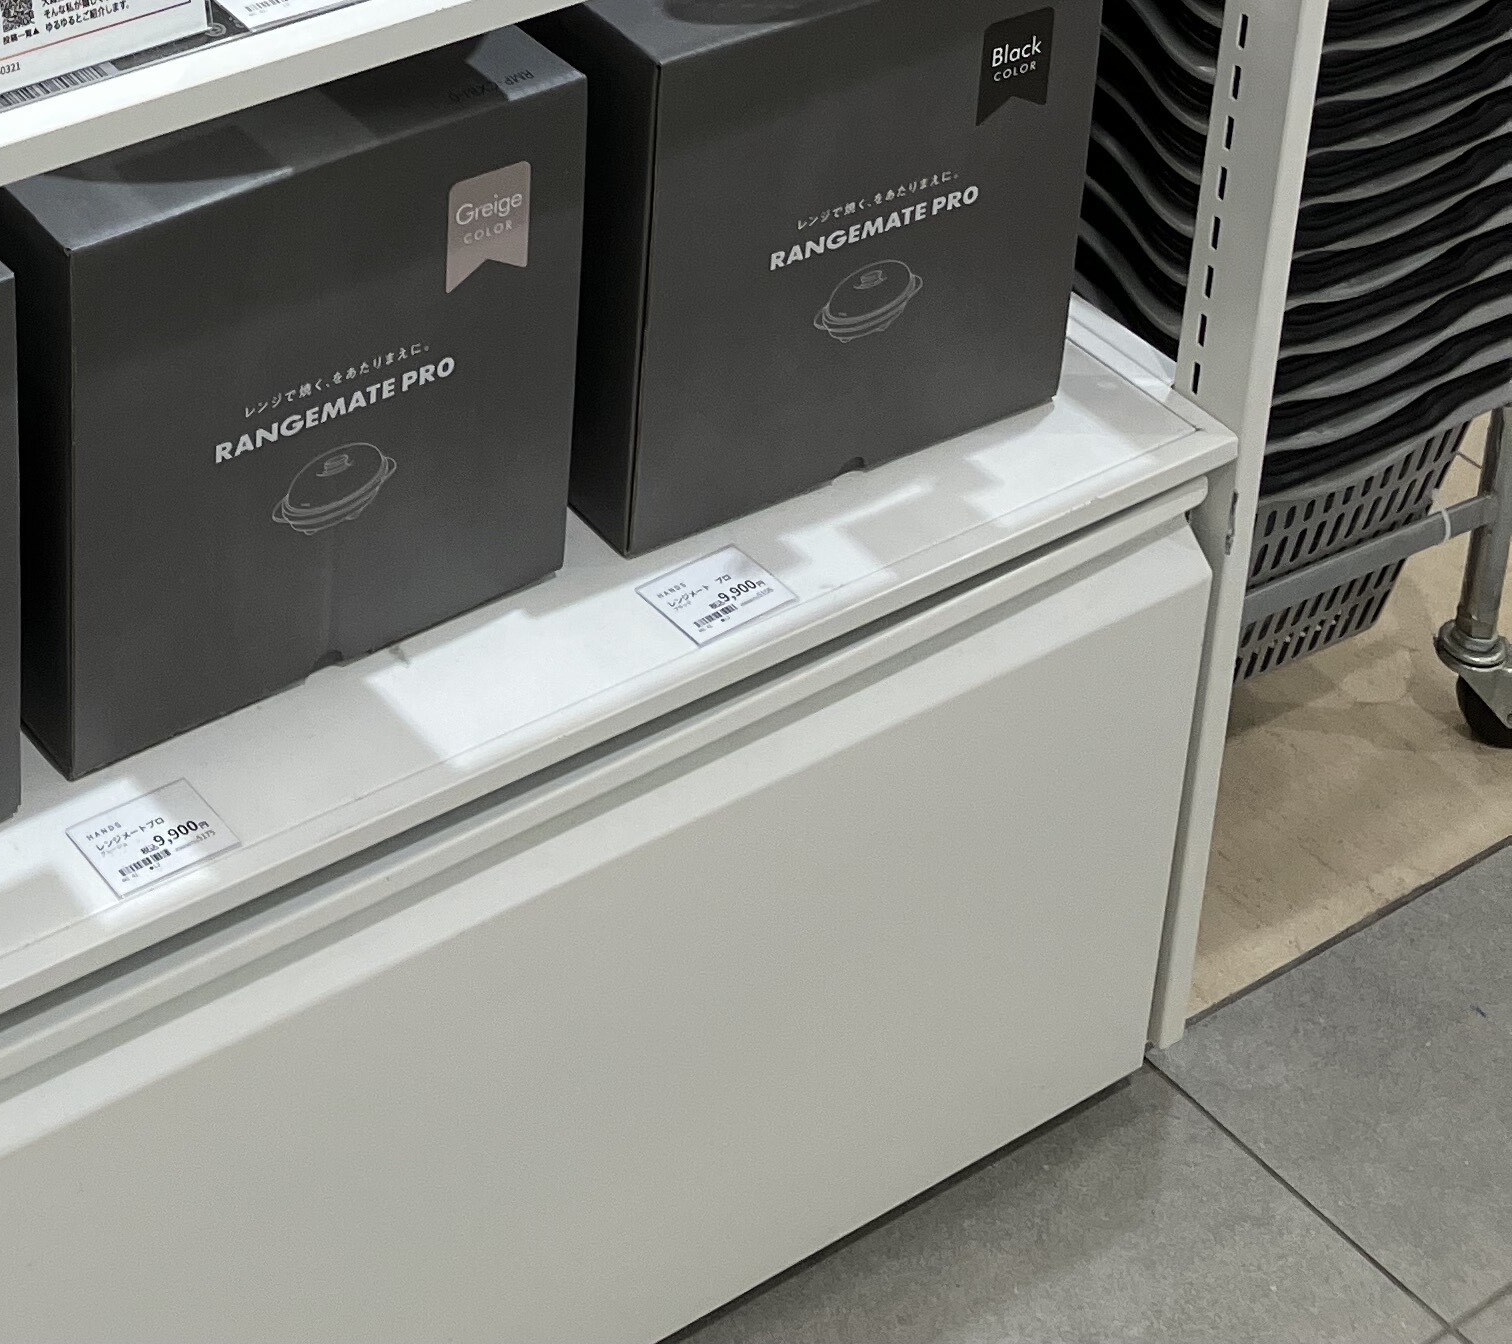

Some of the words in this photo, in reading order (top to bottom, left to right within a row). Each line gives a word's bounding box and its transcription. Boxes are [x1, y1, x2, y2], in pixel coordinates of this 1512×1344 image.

[991, 35, 1042, 69] Black
[992, 60, 1038, 84] COLOR
[454, 188, 524, 226] Greige
[796, 169, 959, 232] レンジで焼く、をあたりまえに。
[462, 218, 514, 247] COLOR
[769, 197, 925, 271] RANGEMATE
[930, 183, 980, 223] PRO
[243, 341, 432, 420] レンジで焼く、をあたりまえに。
[214, 375, 396, 465] RANGEMATE
[400, 355, 456, 406] PRO
[667, 583, 710, 608] レンジメート
[714, 573, 732, 585] プロ
[86, 820, 123, 841] HANDS
[95, 816, 165, 852] レンジメートプロ
